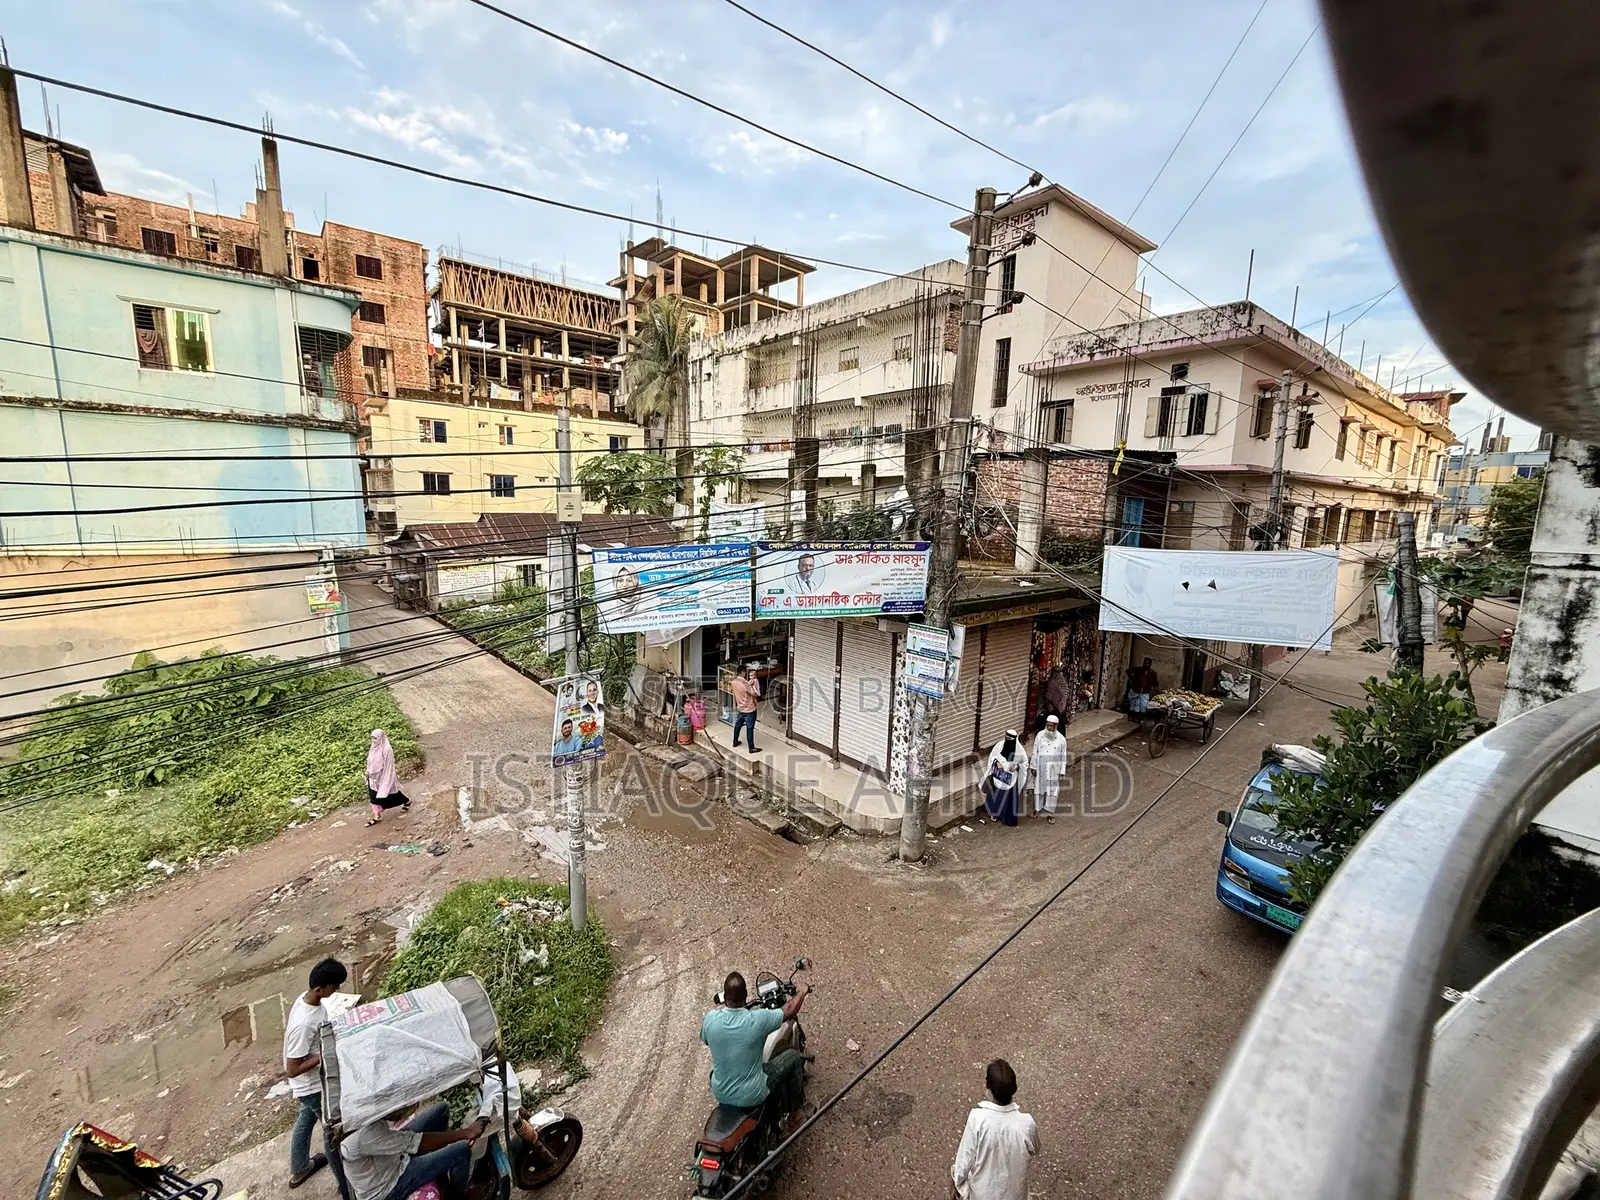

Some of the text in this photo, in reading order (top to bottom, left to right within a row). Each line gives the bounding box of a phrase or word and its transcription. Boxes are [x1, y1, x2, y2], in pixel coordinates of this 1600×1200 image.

[834, 554, 853, 565] ডাঃ
[893, 554, 927, 568] মাহমুদ
[783, 596, 792, 608] এ
[853, 590, 882, 607] সেন্টার
